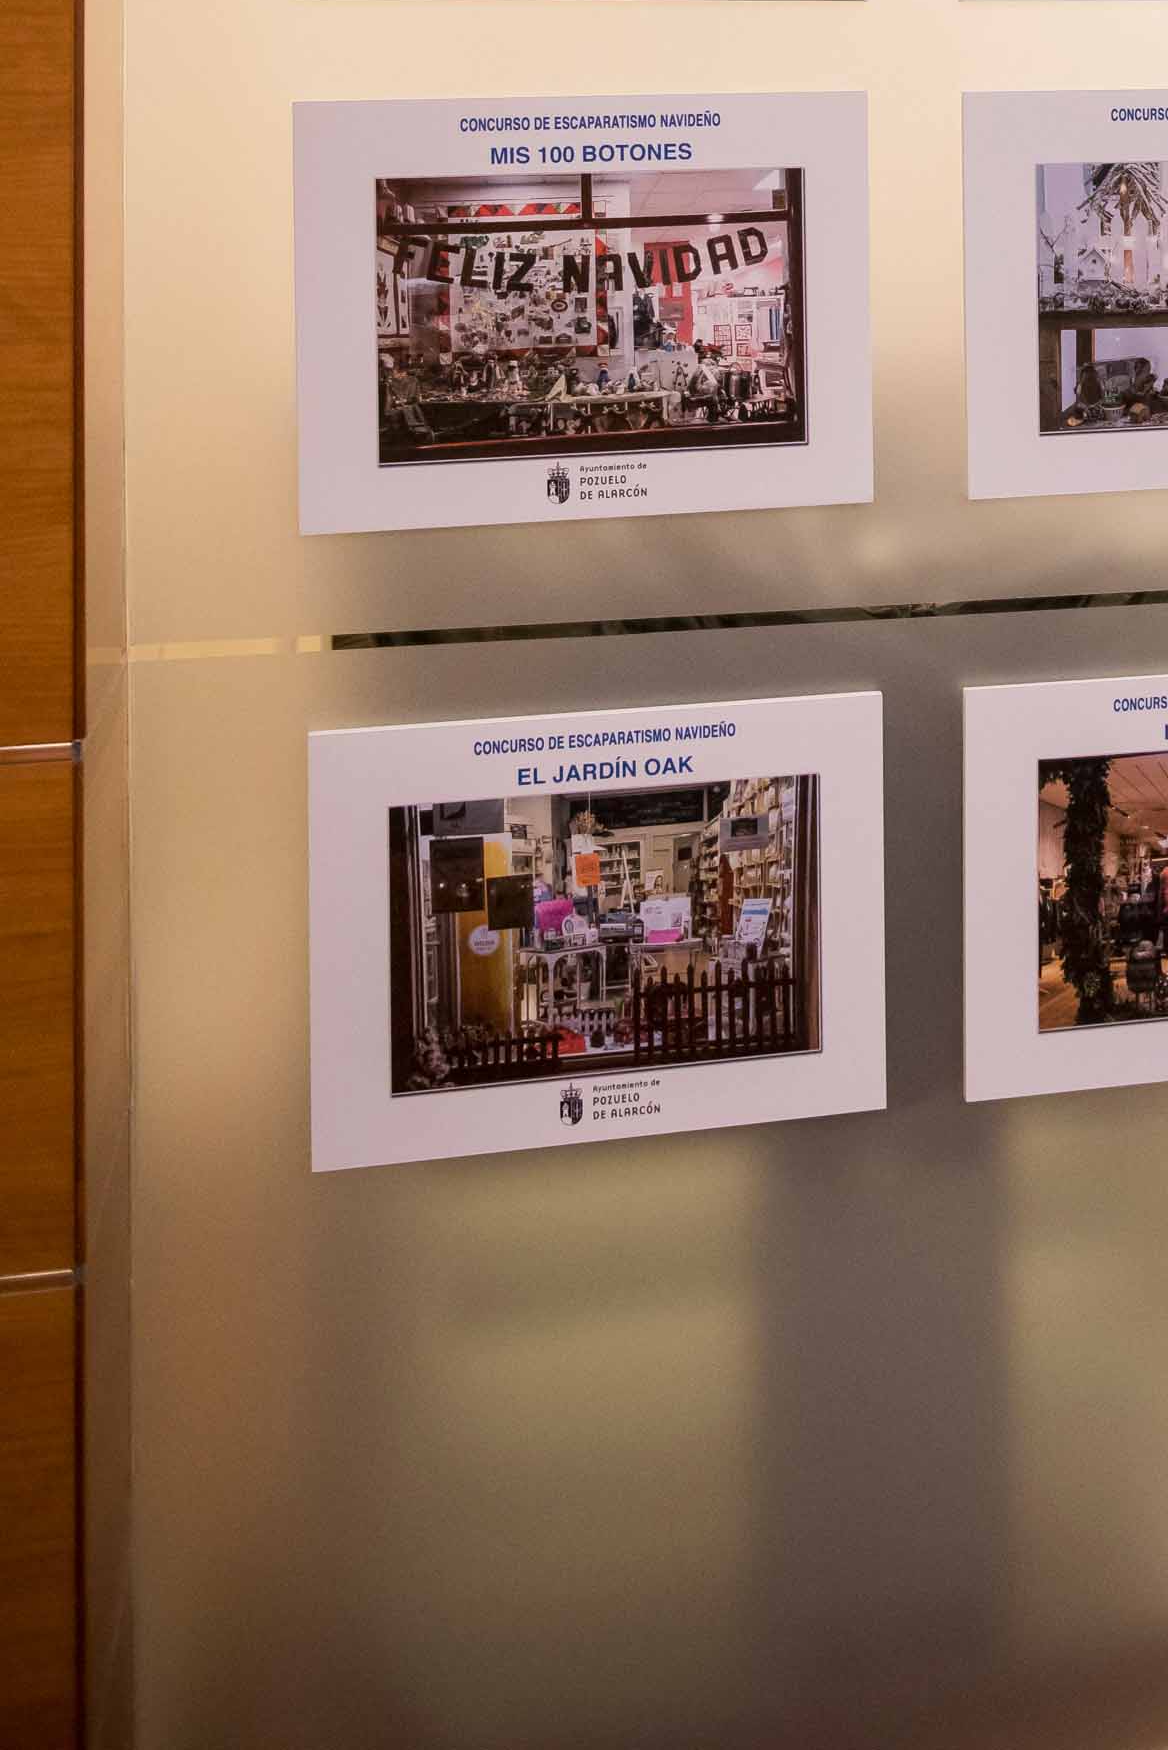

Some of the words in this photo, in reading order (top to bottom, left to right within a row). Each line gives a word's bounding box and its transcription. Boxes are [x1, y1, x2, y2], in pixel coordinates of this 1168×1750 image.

[459, 116, 530, 132] CONCURSO
[533, 116, 550, 130] DE
[554, 114, 656, 129] ESCAPARATISMO
[660, 110, 720, 127] NAVIDEÑO
[490, 146, 530, 164] MIS
[538, 145, 574, 163] 100
[582, 142, 691, 162] BOTONES
[393, 234, 536, 293] FELIZ
[562, 226, 769, 294] NAVIDAD
[579, 463, 634, 474] Ayuntamiento
[636, 461, 646, 469] de
[579, 474, 626, 486] POZUELO
[579, 490, 592, 500] DE
[597, 483, 647, 498] ALARCÓN
[473, 737, 544, 755] CONCURSO
[548, 735, 564, 750] DE
[568, 727, 671, 748] ESCAPARATISMO
[675, 720, 735, 740] NAVIDEÑO
[517, 767, 546, 786] EL
[552, 759, 636, 783] JARDÍN
[644, 755, 693, 775] OAK
[592, 1080, 648, 1094] Ayuntamiento
[650, 1078, 660, 1086] de
[592, 1092, 639, 1106] POZUELO
[592, 1109, 606, 1120] DE
[610, 1100, 660, 1118] ALARCÓN
